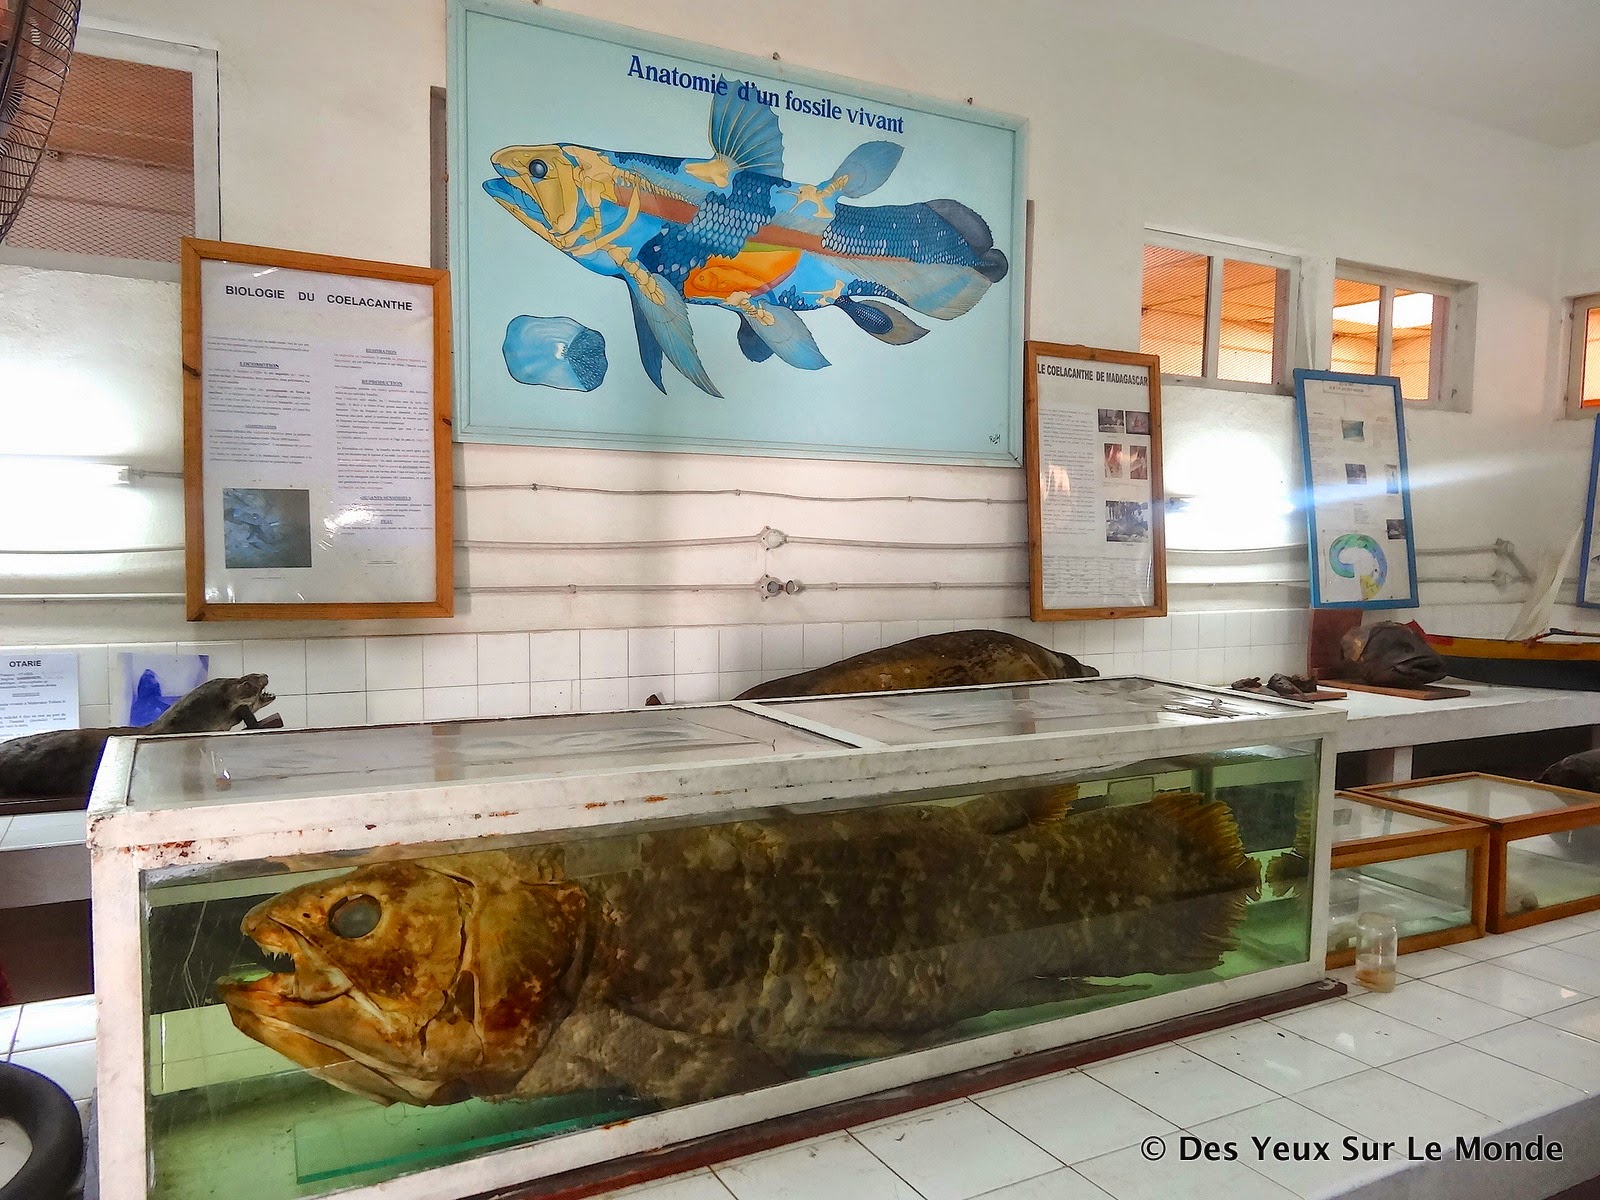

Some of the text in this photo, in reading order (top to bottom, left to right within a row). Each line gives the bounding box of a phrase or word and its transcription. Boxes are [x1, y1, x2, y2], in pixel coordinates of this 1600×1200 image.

[627, 54, 904, 134] Anatomie d'un fossile vivant
[225, 285, 413, 311] BIOLOGIE DU COELACANTHE
[1037, 363, 1148, 386] LE COELACANTHE DE MADAGASCAR
[9, 660, 41, 668] OTARIE
